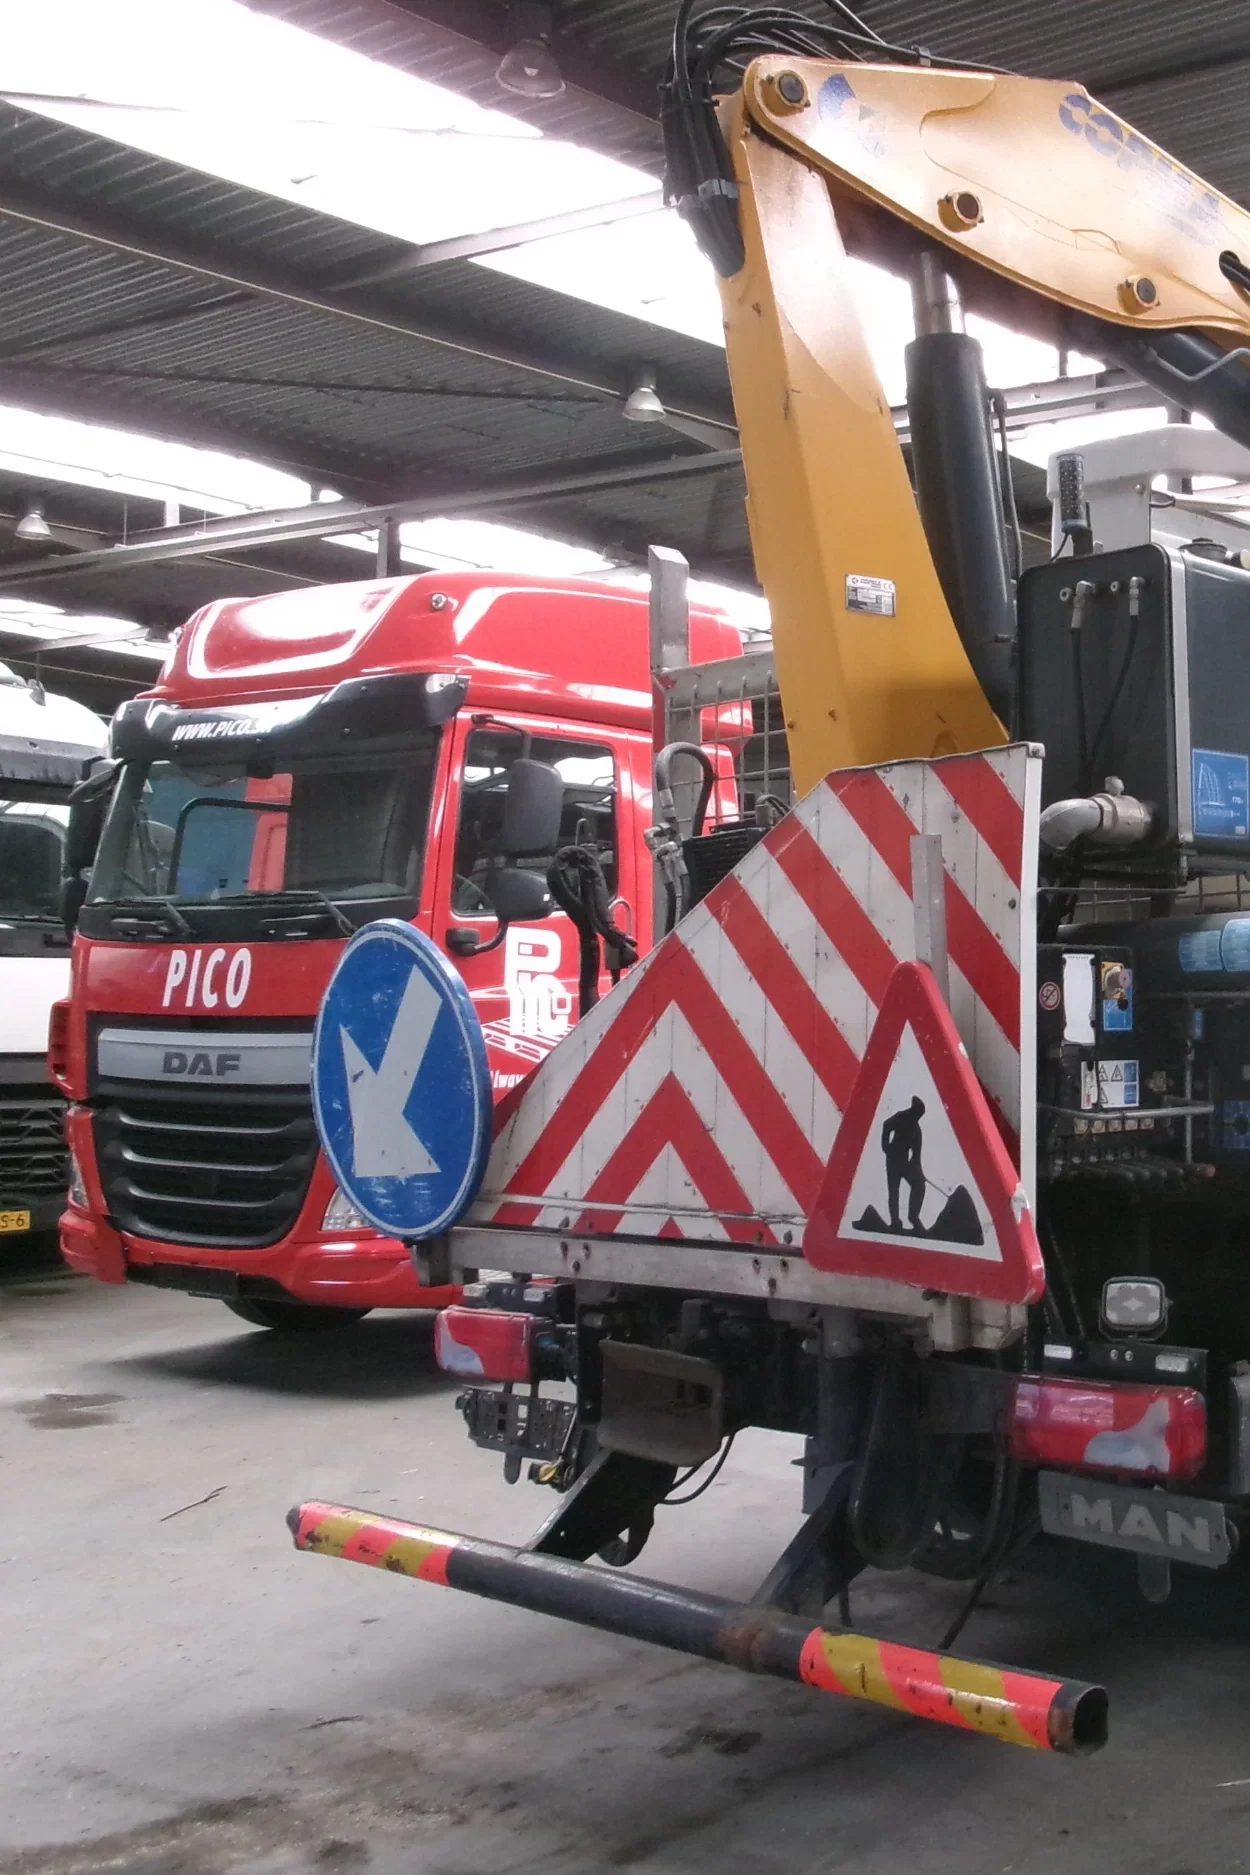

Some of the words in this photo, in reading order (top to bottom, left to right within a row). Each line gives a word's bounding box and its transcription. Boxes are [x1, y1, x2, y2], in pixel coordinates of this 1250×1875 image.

[162, 947, 252, 1008] PICO
[162, 1051, 241, 1076] DAF
[1071, 1493, 1211, 1553] MAN
